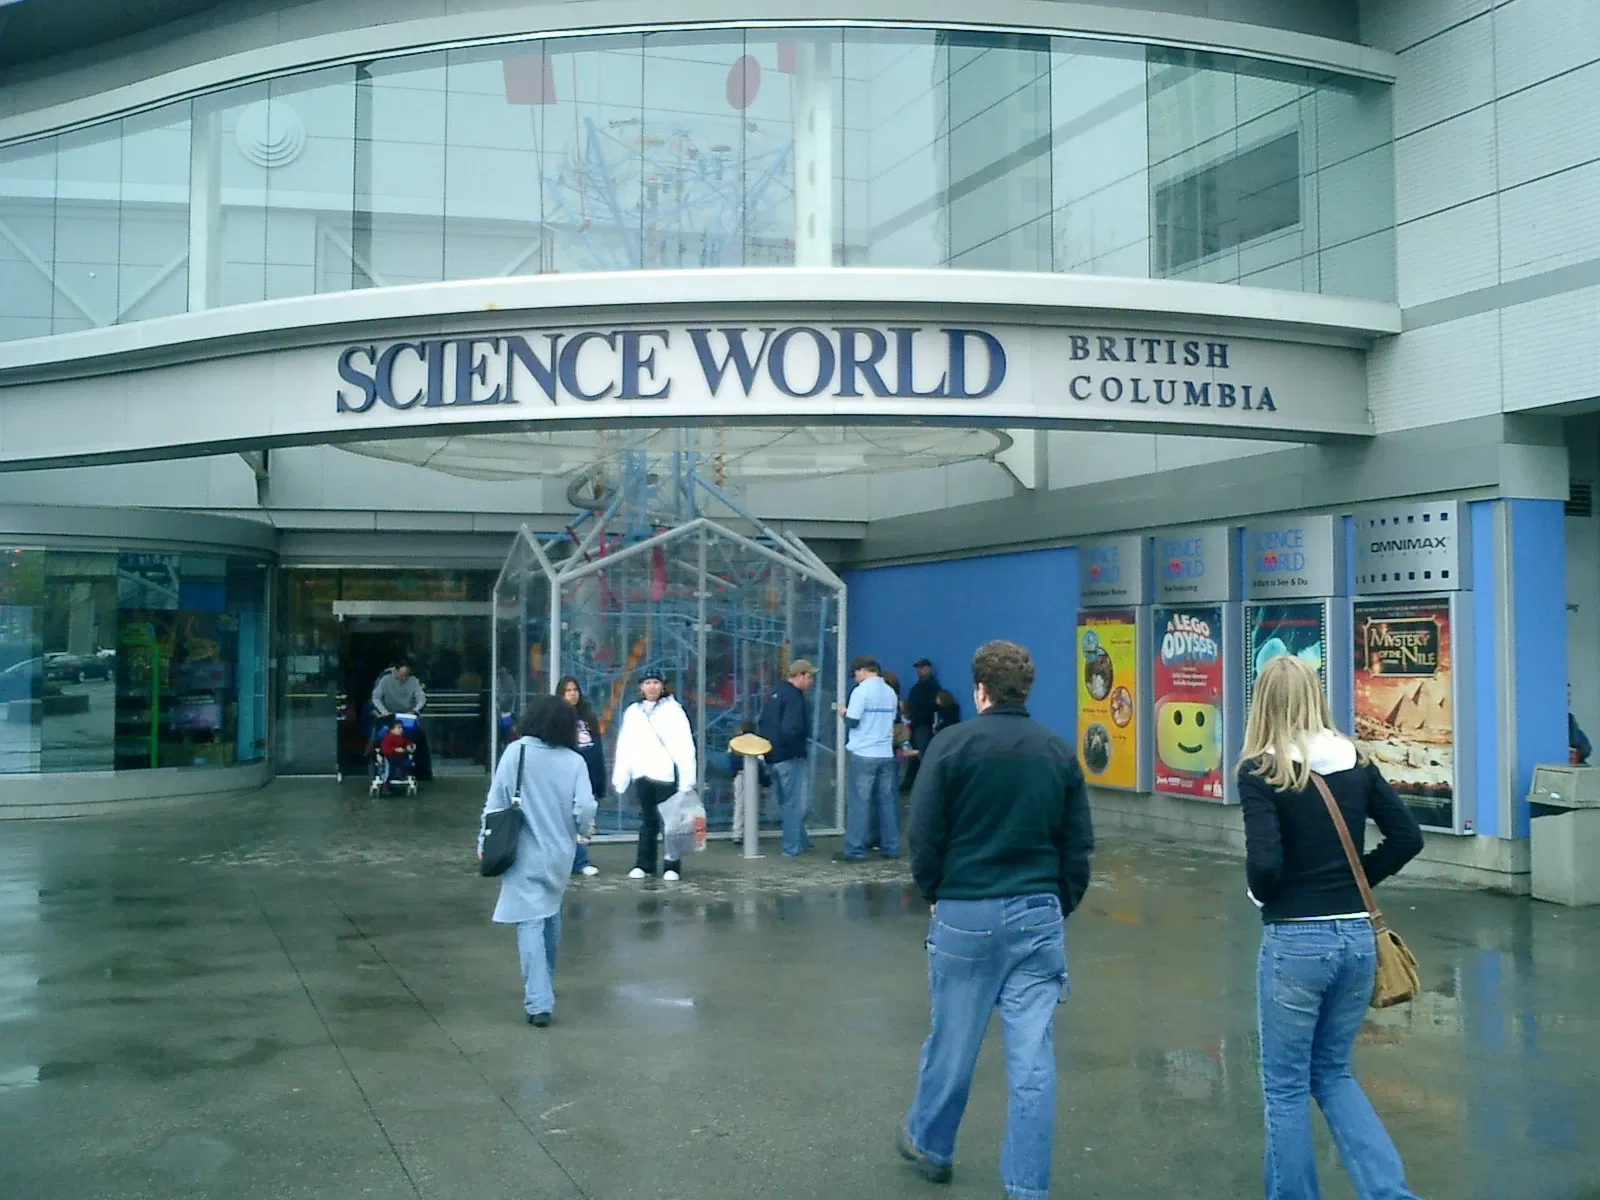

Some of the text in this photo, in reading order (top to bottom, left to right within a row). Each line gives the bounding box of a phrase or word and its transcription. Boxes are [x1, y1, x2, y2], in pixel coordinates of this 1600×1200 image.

[1068, 335, 1230, 369] BRITISH
[336, 326, 1006, 414] SCIENCE WORLD
[1068, 374, 1278, 412] COLUMBIA
[1161, 538, 1203, 558] CIENCE
[1370, 536, 1447, 553] OMNIMAX
[1166, 613, 1211, 638] A LEGO
[1370, 627, 1432, 649] MYSTERY
[1161, 630, 1218, 660] ODYSSEY
[1401, 645, 1438, 666] NILE
